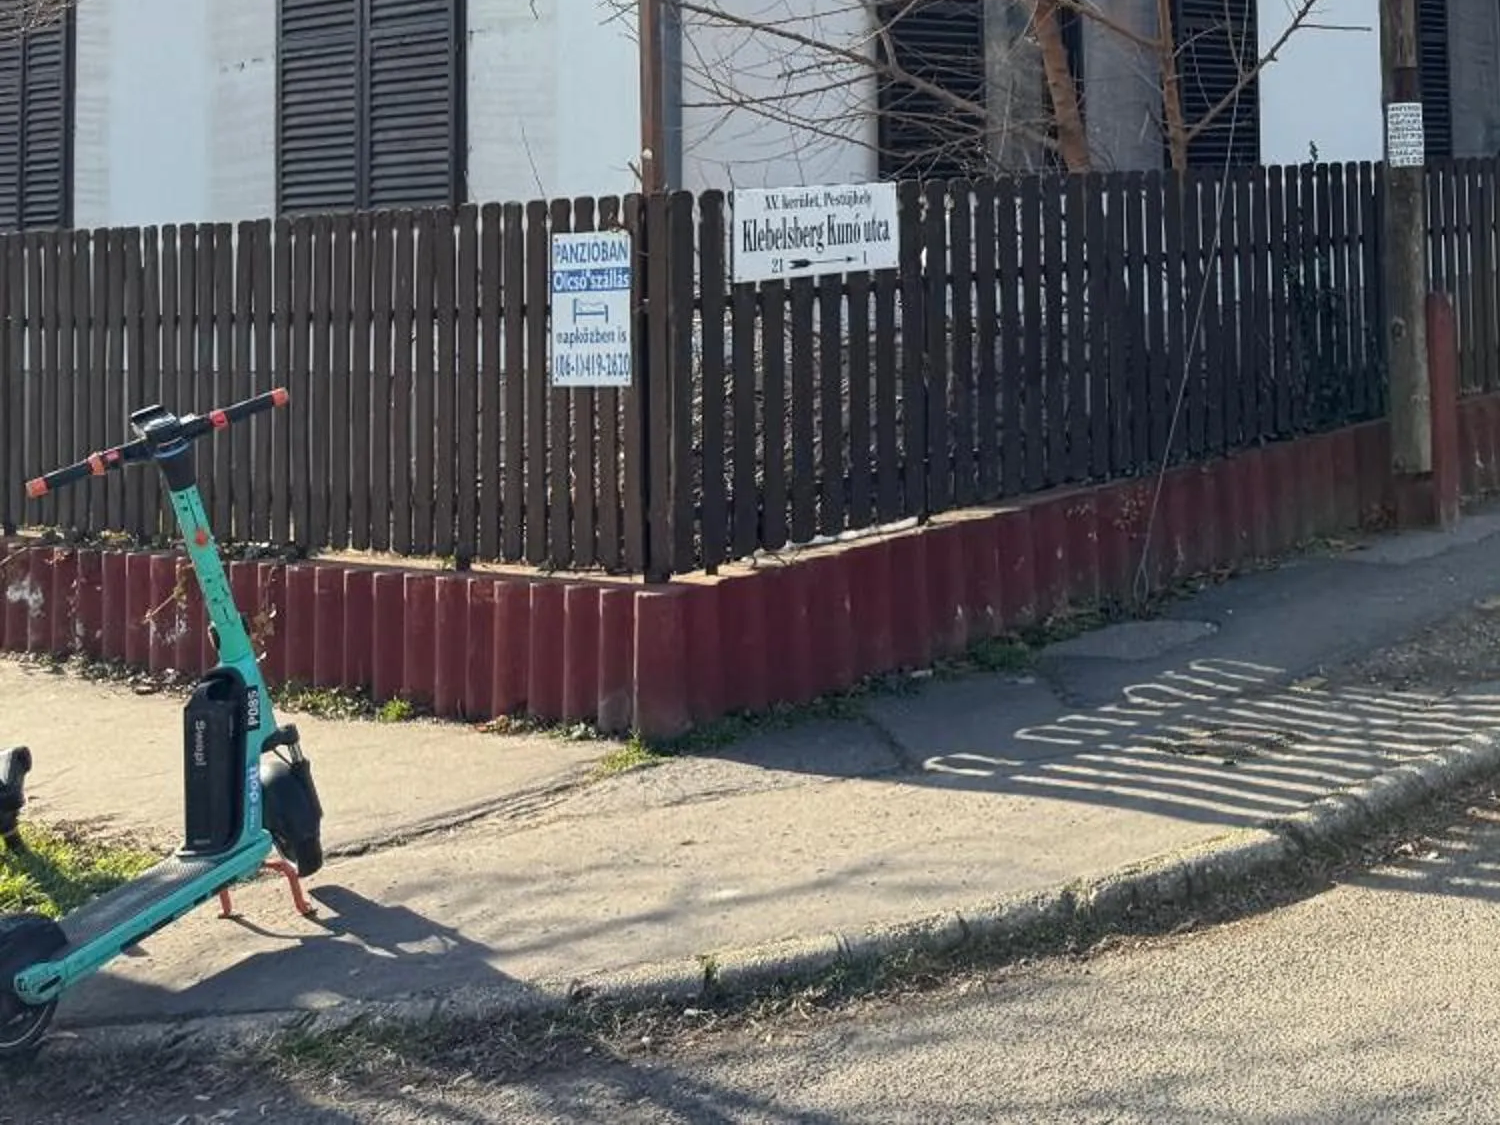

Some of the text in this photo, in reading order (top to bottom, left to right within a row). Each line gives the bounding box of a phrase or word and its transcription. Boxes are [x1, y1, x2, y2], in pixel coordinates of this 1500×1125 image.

[742, 213, 891, 253] Klebelsberg Kunó utca
[771, 257, 783, 273] 21
[617, 324, 627, 344] is
